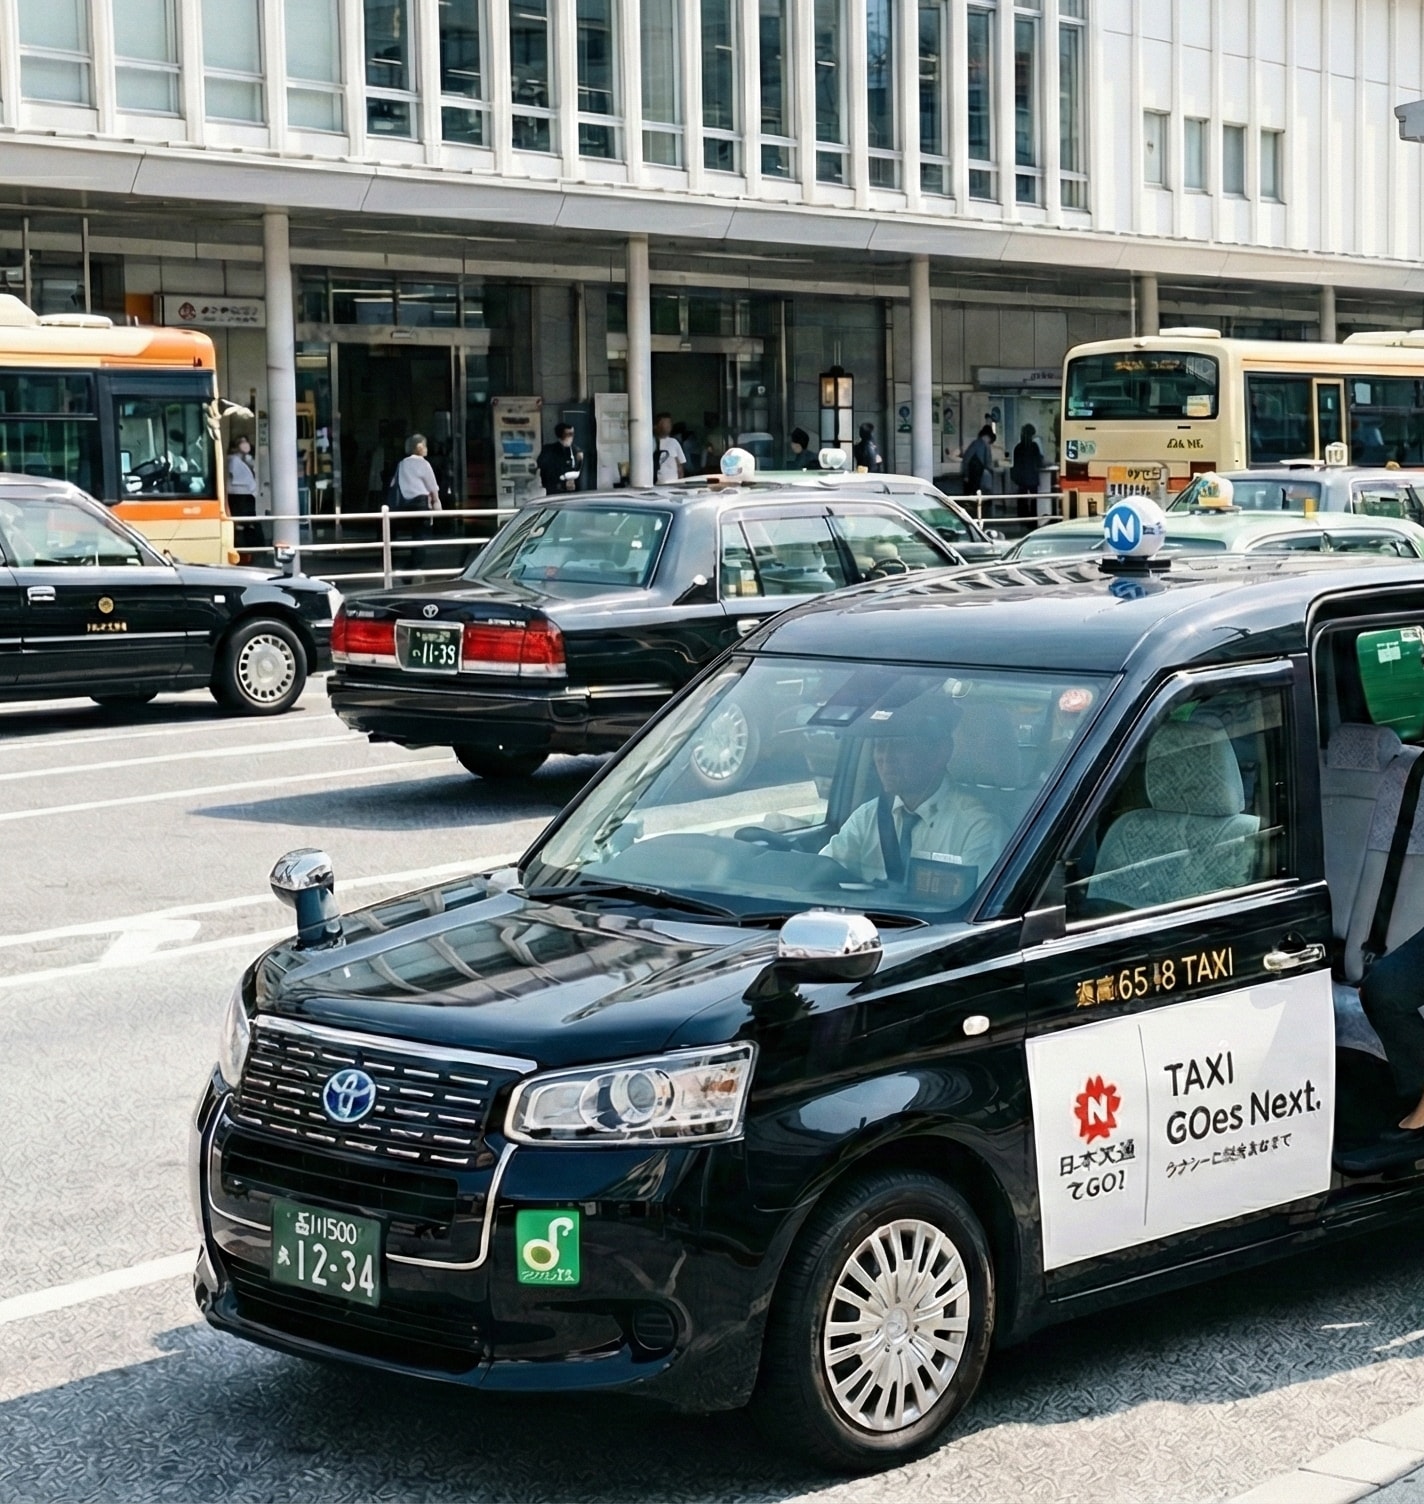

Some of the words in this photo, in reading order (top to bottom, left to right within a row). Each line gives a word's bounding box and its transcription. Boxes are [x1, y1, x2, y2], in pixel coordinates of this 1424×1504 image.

[1111, 513, 1135, 543] N
[1181, 947, 1233, 985] TAXI
[1164, 1051, 1233, 1096] TAXI
[1087, 1093, 1108, 1126] N
[1166, 1104, 1243, 1144] GOes
[1250, 1080, 1321, 1126] Next.
